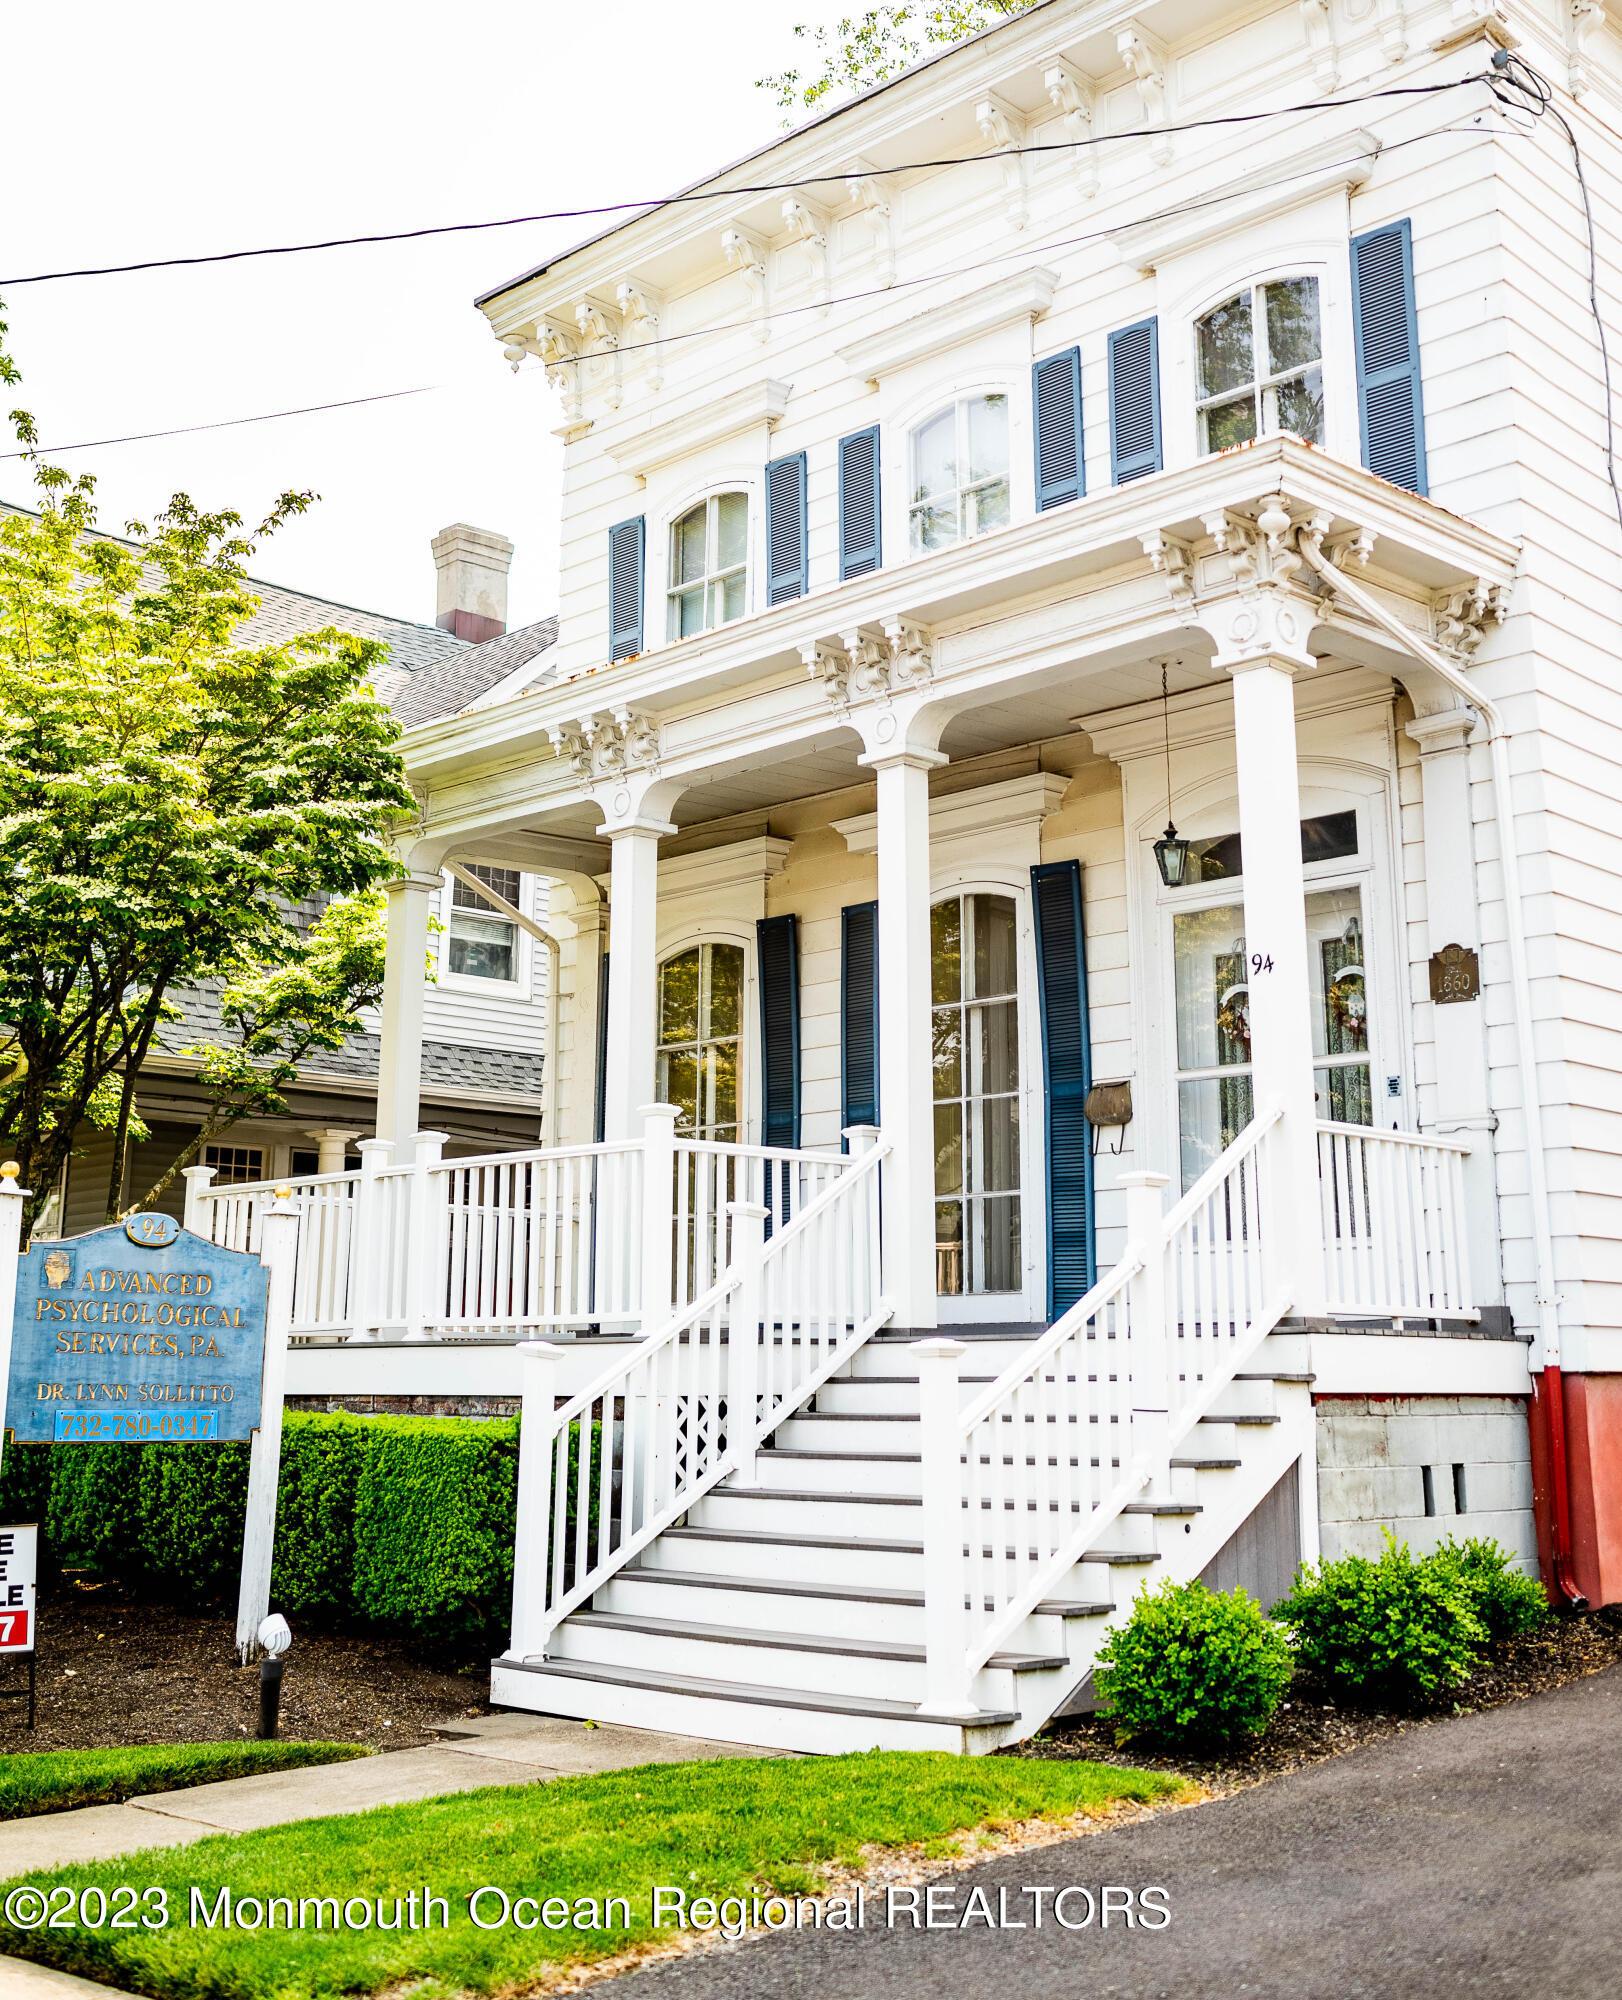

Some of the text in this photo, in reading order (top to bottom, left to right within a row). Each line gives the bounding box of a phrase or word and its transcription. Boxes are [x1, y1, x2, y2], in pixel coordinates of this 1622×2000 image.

[1252, 953, 1274, 976] 94
[1438, 973, 1470, 993] 1860
[143, 1218, 166, 1240] 94
[79, 1270, 212, 1296] ADVANCED
[36, 1298, 246, 1328] PSYCHOLOGICAL
[56, 1331, 225, 1359] SERVICES, P.A.
[37, 1383, 236, 1403] DR. LYNN SOLLITTO
[61, 1415, 213, 1438] 732-780-0347
